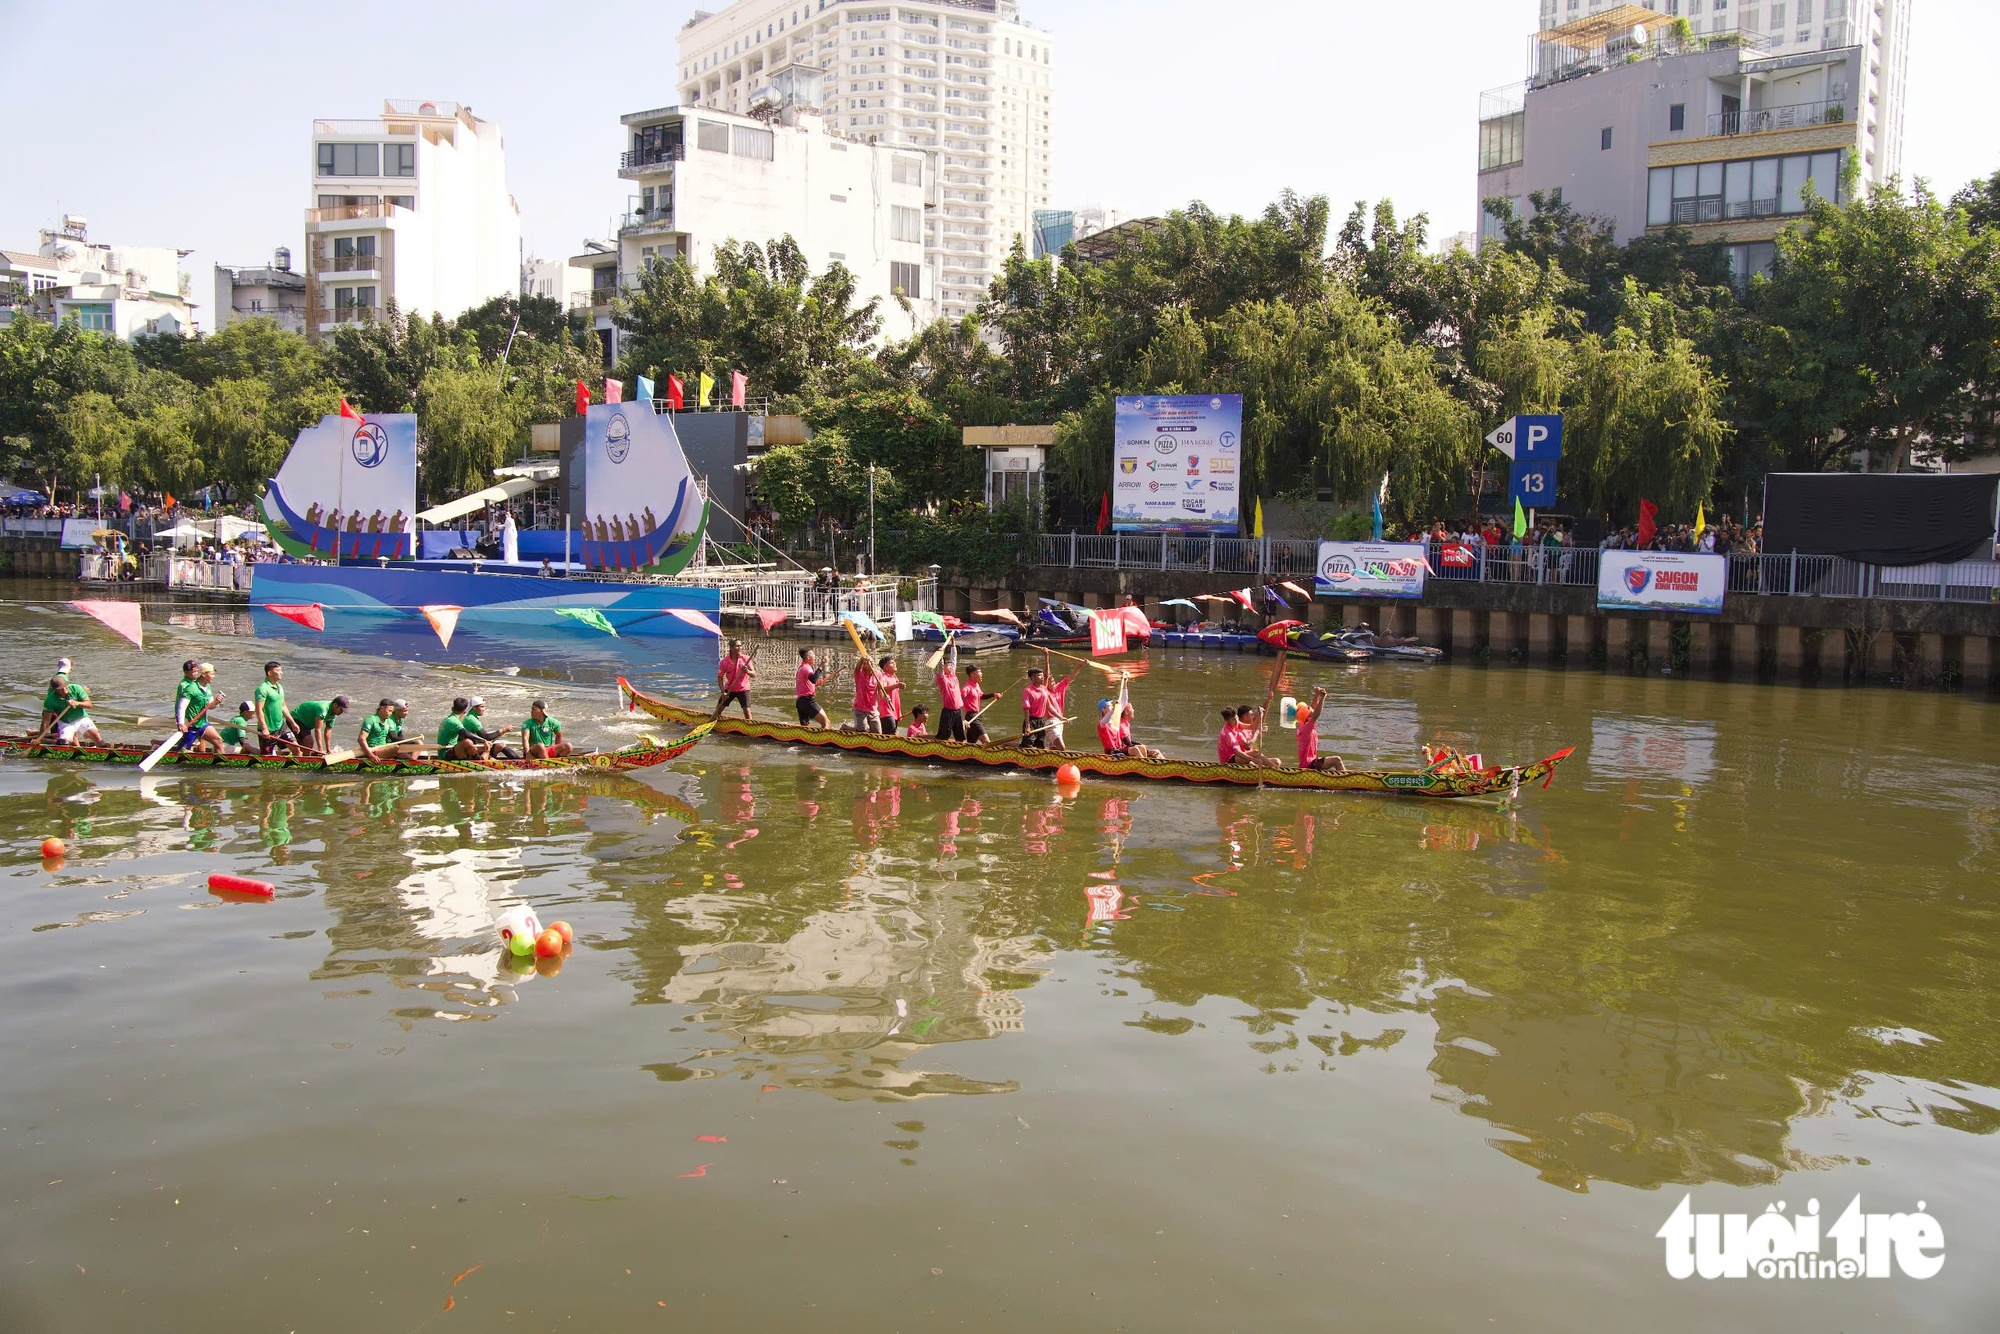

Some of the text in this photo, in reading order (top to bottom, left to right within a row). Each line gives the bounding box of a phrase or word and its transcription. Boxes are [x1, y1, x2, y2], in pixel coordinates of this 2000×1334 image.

[1158, 440, 1173, 448] PIZZA
[1496, 432, 1512, 444] 60
[1528, 425, 1548, 450] P
[1210, 458, 1234, 469] STC
[1522, 474, 1544, 492] 13
[1327, 563, 1350, 574] PIZZA
[1656, 570, 1698, 584] SAIGON
[1469, 756, 1478, 770] 1
